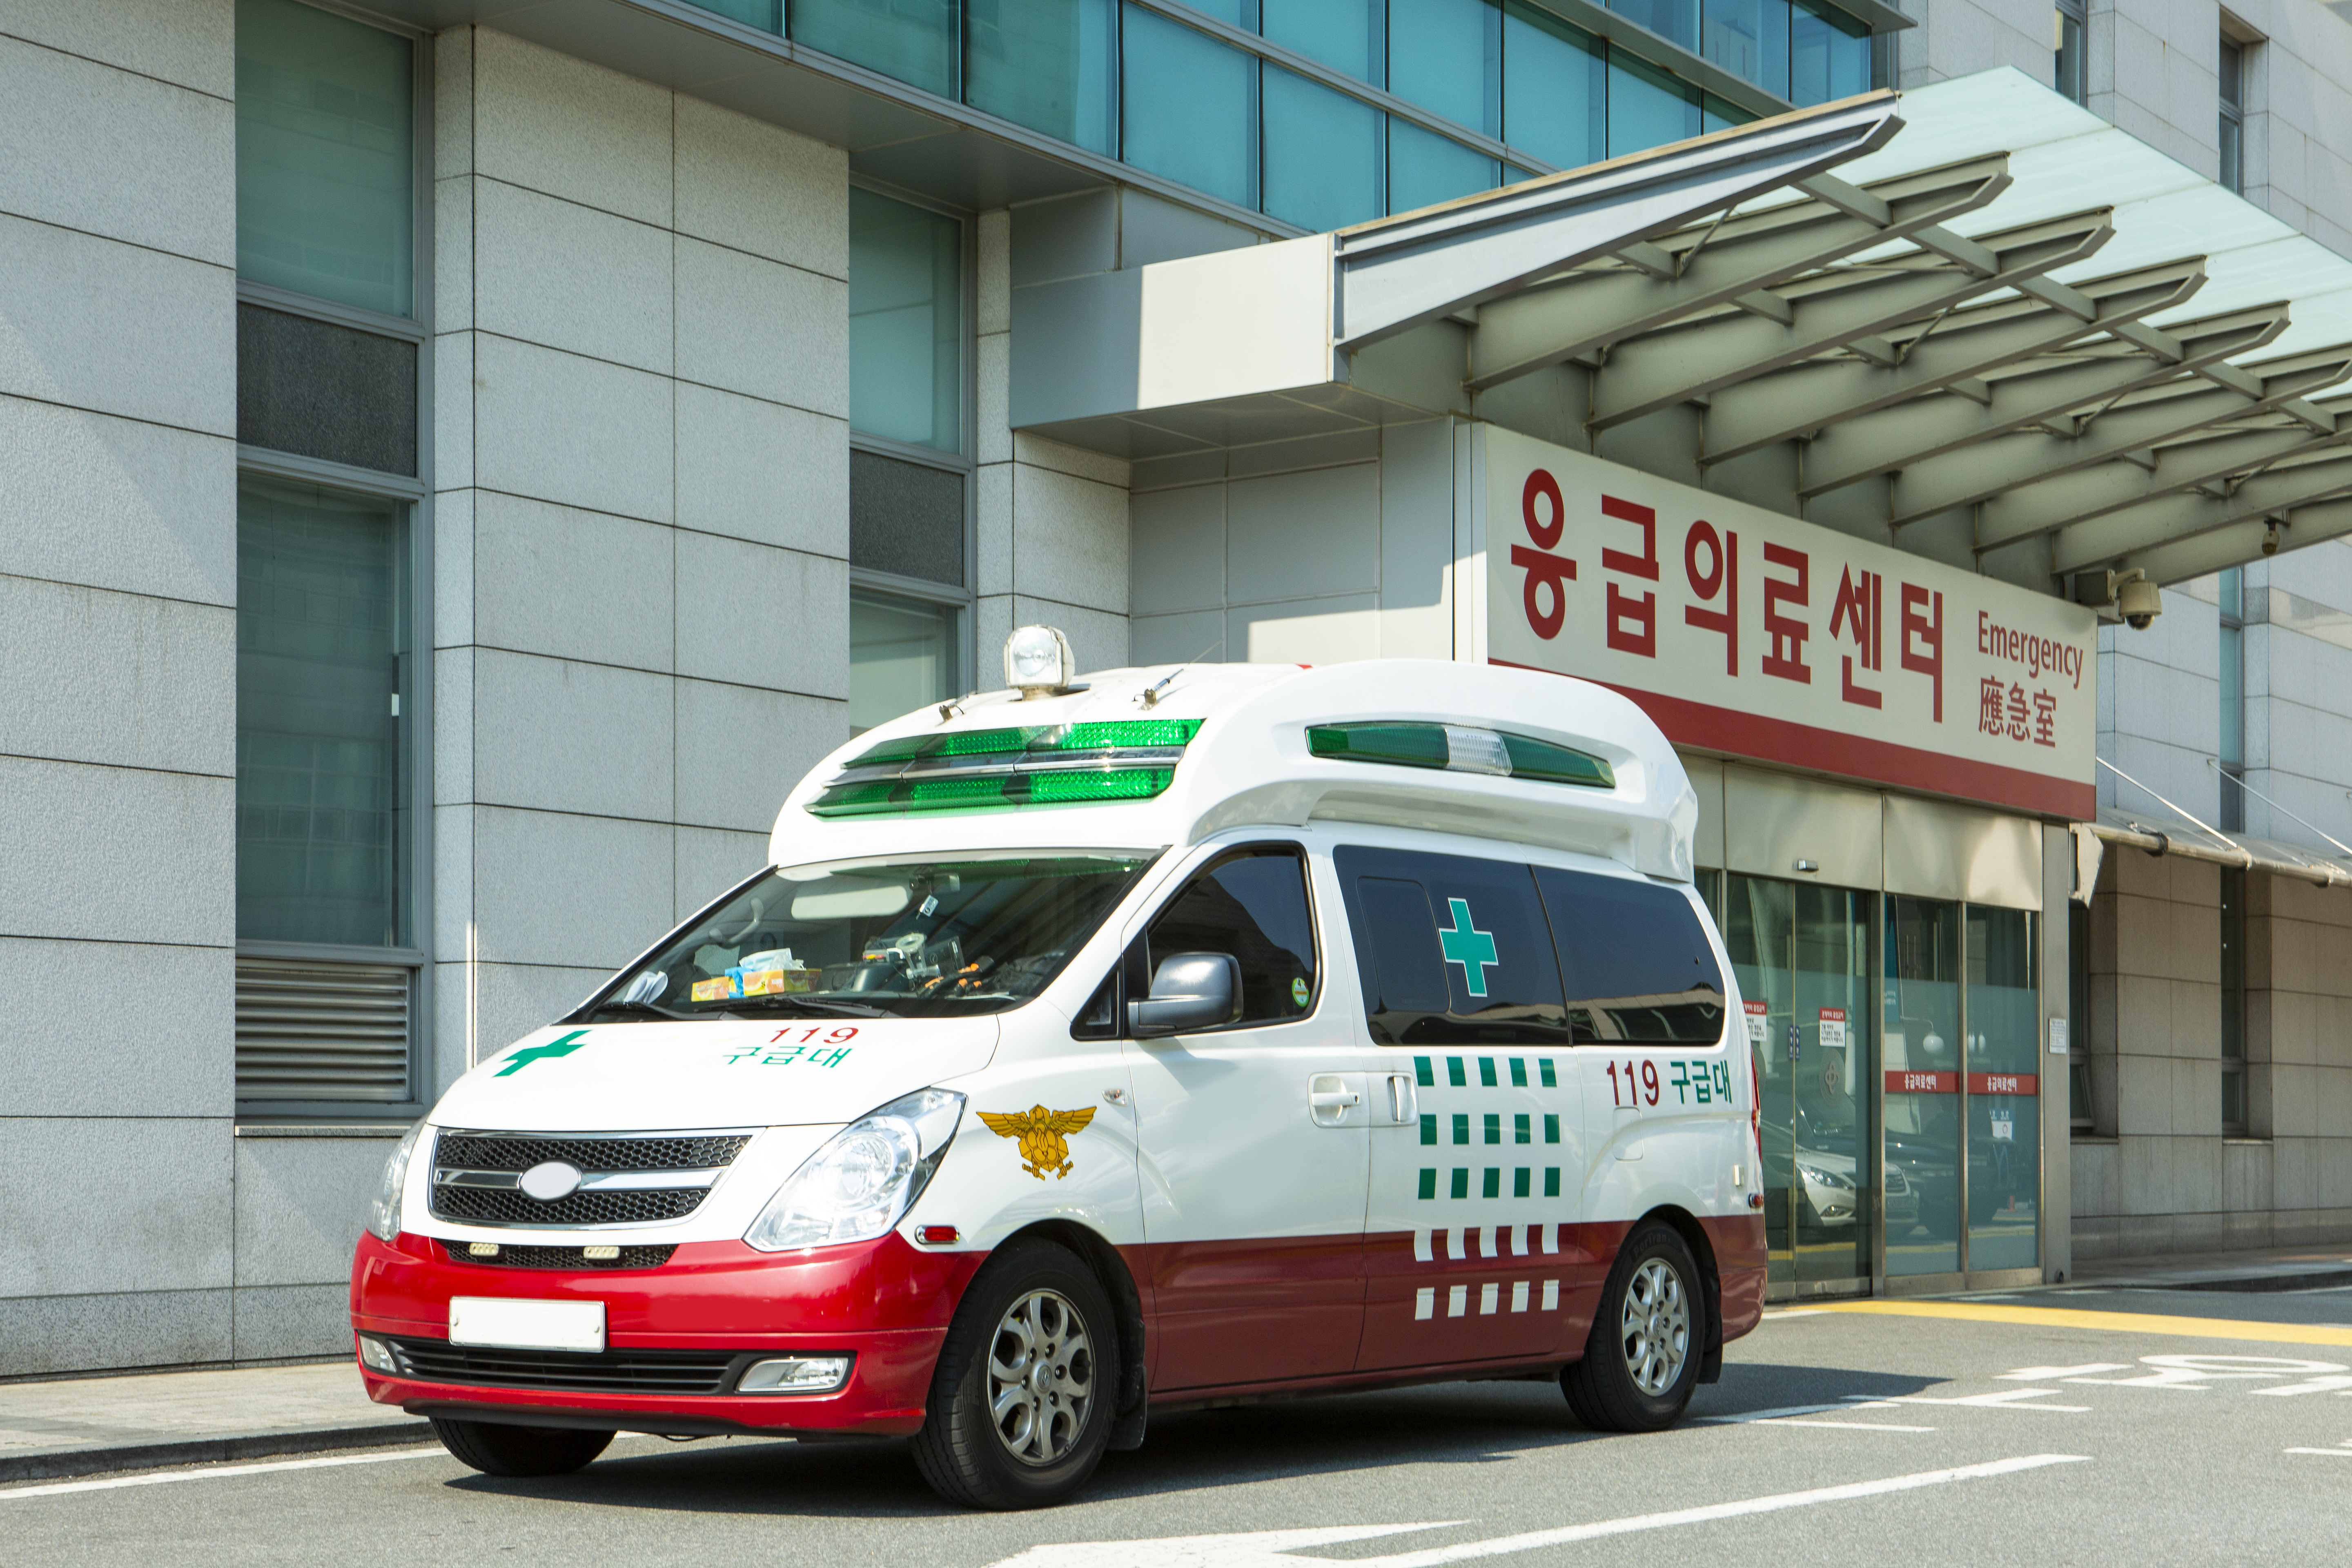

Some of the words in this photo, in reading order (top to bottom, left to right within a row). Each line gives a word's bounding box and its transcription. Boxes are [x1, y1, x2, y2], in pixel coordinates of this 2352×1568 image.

[1511, 469, 1942, 722] 응급의료센터
[1978, 610, 2083, 689] Emergency
[1978, 675, 2056, 747] 應急室
[770, 1027, 859, 1044] 119
[722, 1046, 853, 1068] 구급대
[1607, 1060, 1659, 1106] 119
[1670, 1060, 1733, 1104] 구급대
[1904, 1074, 1937, 1090] 응급의료센터
[1987, 1076, 2017, 1092] 응급의료센터
